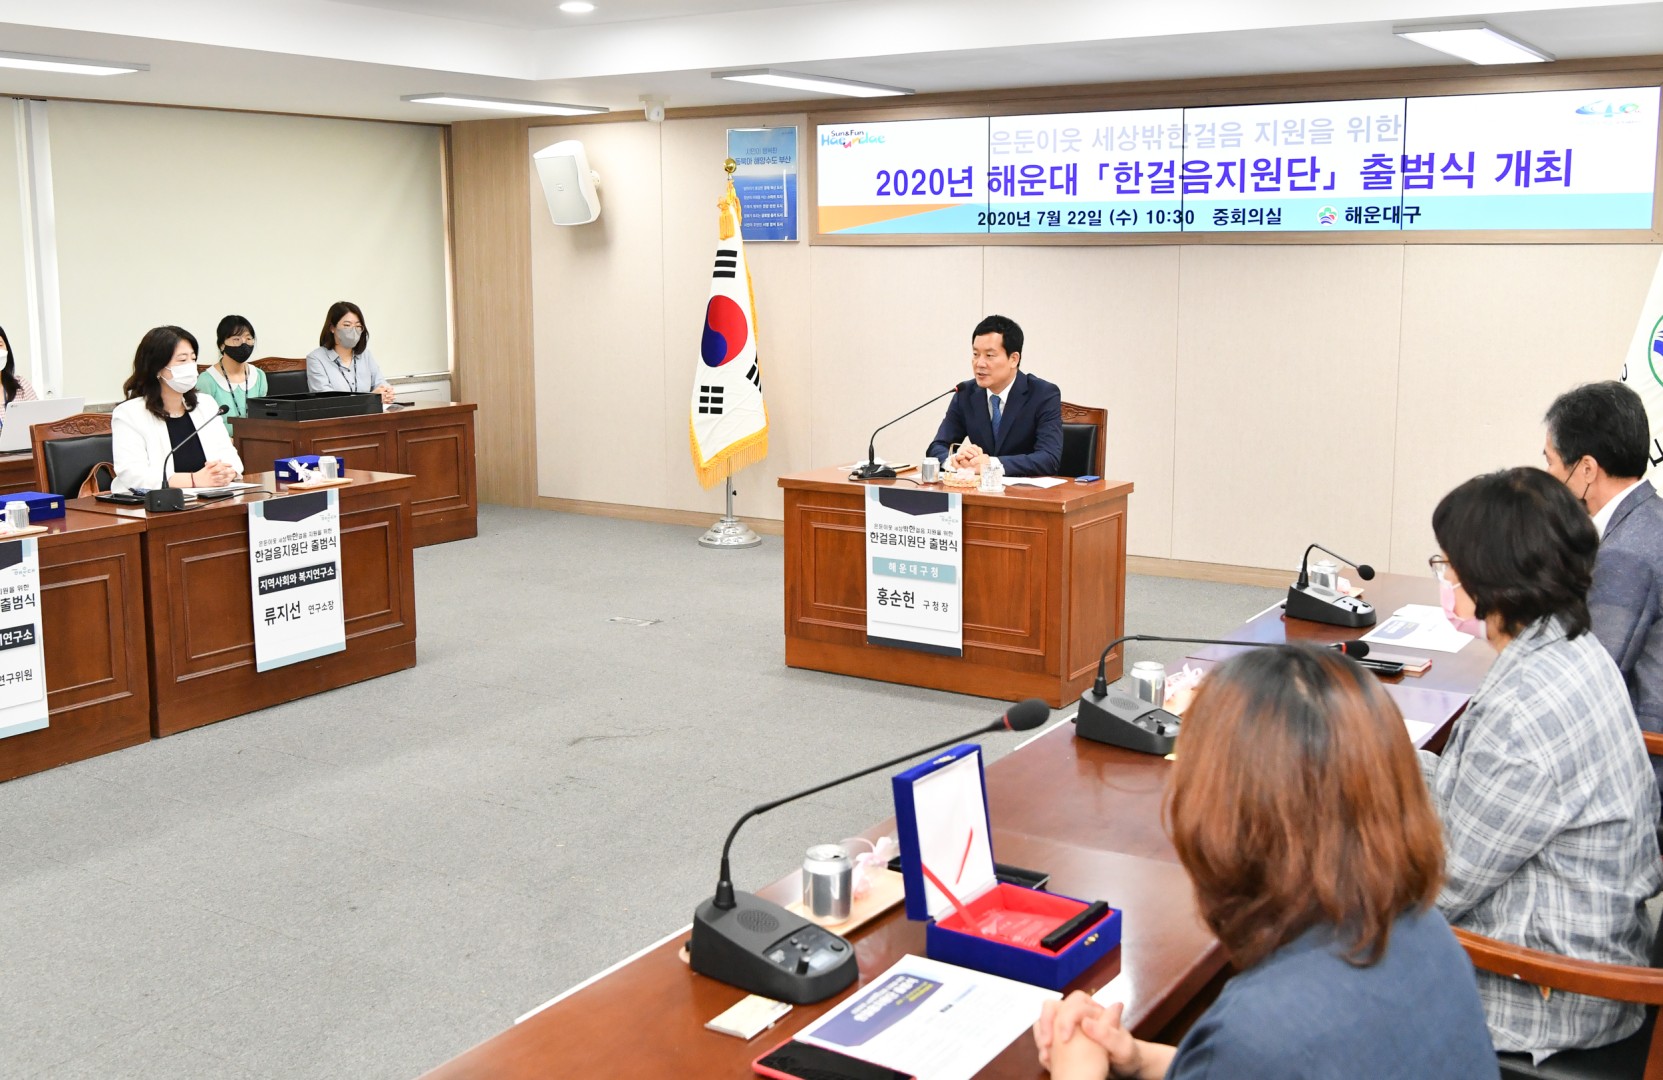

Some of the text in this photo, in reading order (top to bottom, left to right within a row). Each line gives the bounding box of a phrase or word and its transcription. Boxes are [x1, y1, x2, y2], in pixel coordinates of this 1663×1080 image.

[990, 127, 1082, 155] 은둔이웃
[1254, 116, 1334, 147] 지원을
[1346, 113, 1402, 144] 위한
[779, 155, 791, 164] 부산
[876, 166, 973, 198] 2020년
[987, 162, 1077, 197] 해운대
[1360, 151, 1476, 190] 출범식
[1495, 148, 1573, 188] 개최
[978, 207, 1282, 227] 2020년 7월 22일 (수) 10:30 중회의실
[1345, 205, 1422, 224] 해운대구
[255, 535, 337, 563] 한걸음지원단 출범식
[870, 531, 958, 552] 한걸음지원단 출범식
[260, 566, 335, 591] 지역사회와 복지연구소
[888, 561, 939, 578] 해운대구청
[0, 593, 36, 613] 출범식
[876, 587, 949, 613] 홍순헌 구청장
[264, 600, 334, 626] 류지선 연구소장
